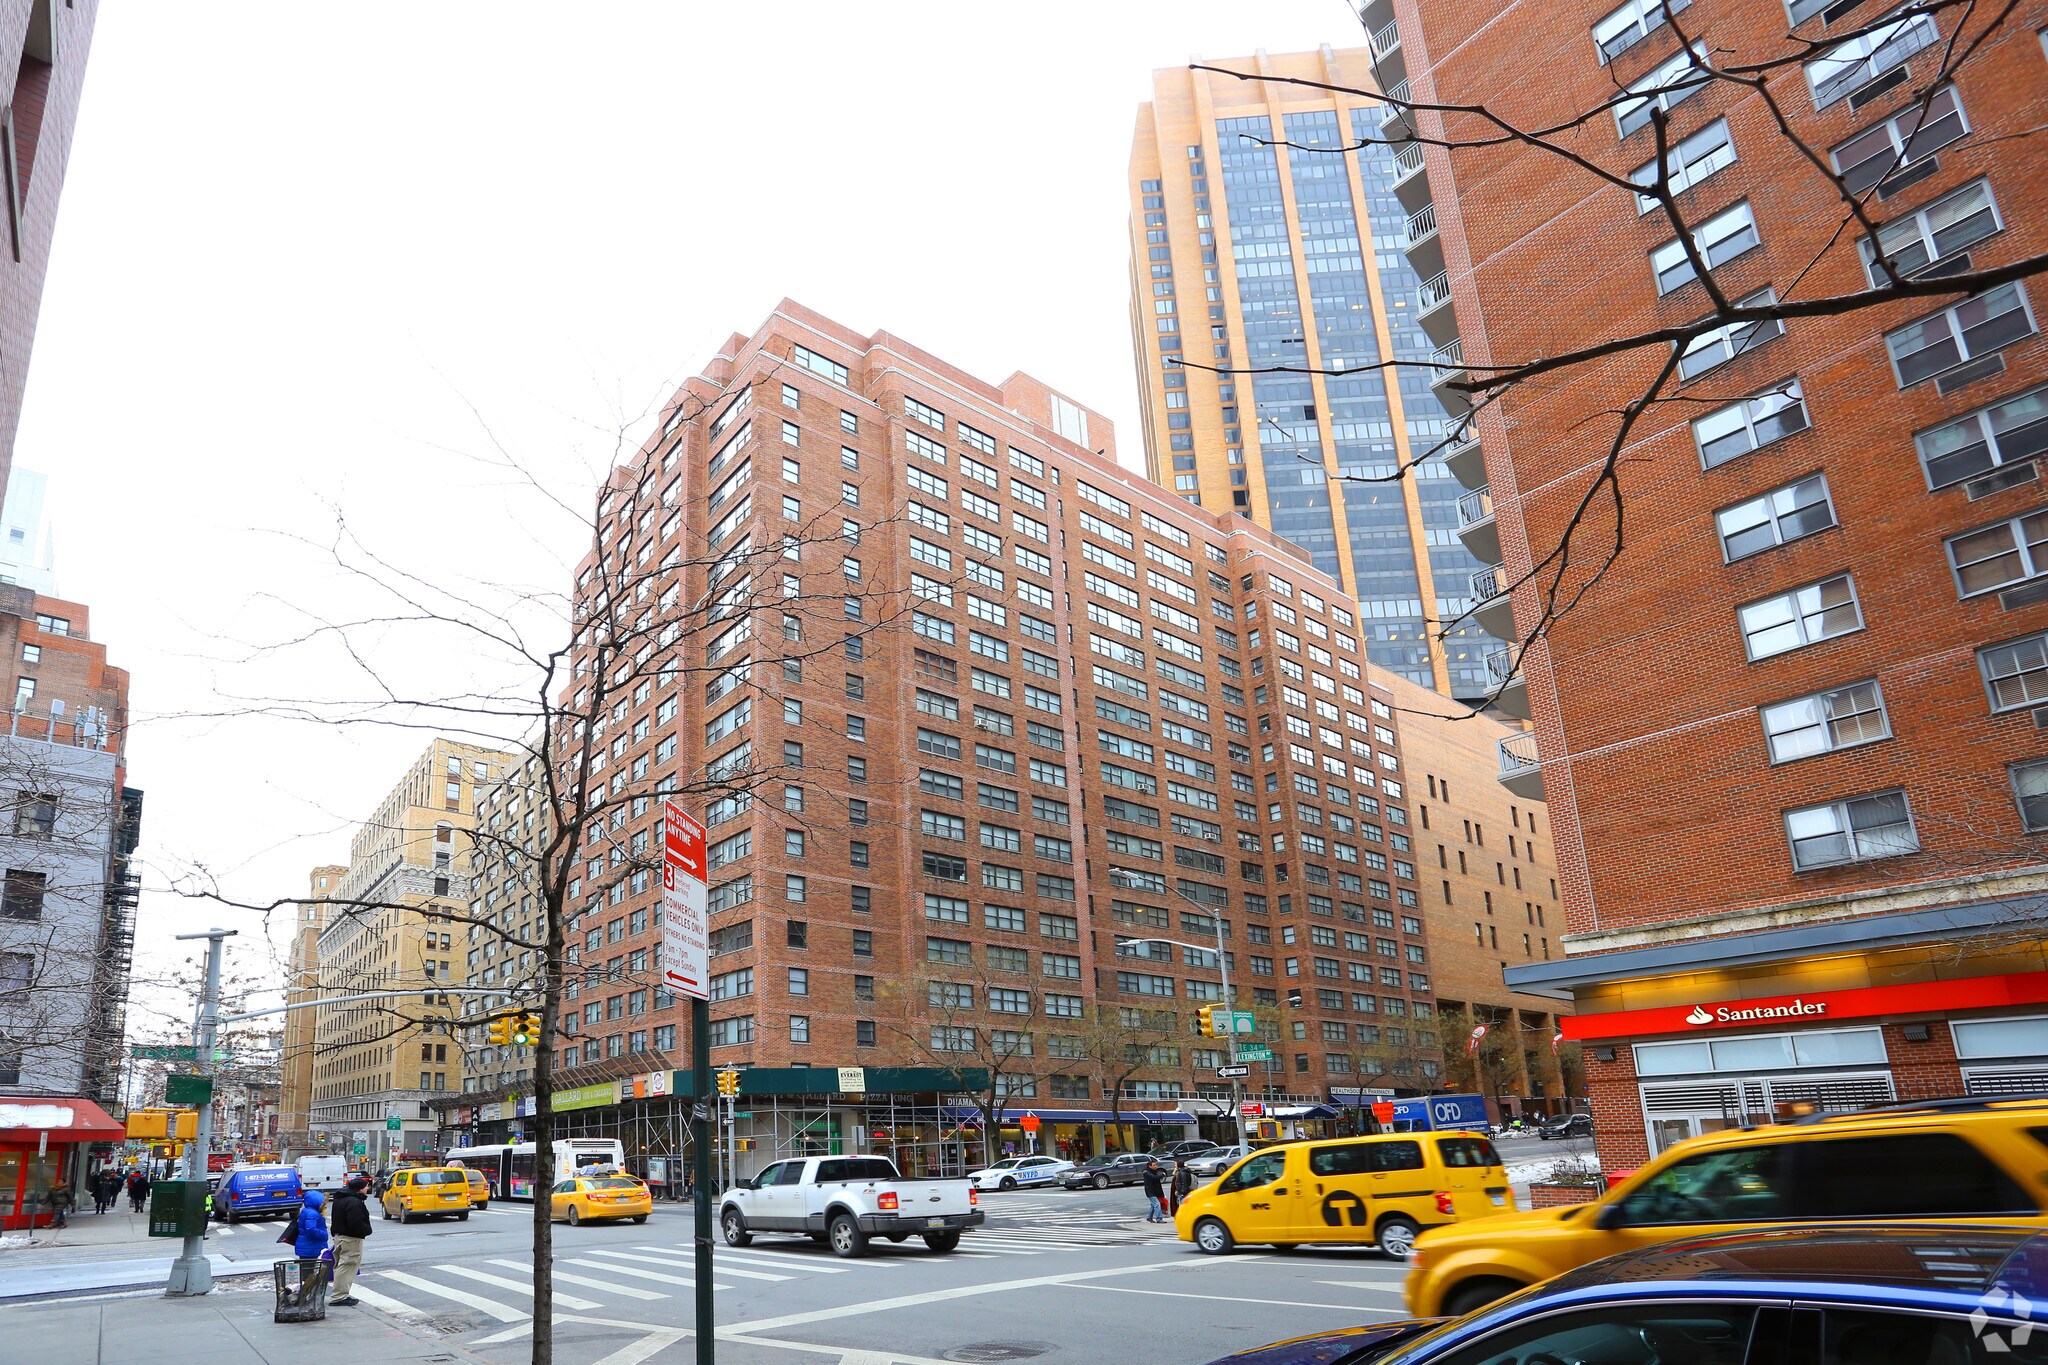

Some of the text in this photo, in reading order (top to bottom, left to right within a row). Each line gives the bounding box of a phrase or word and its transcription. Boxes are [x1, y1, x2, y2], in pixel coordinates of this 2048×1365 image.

[667, 807, 701, 840] NO STANDING
[667, 822, 691, 846] ANYTIME
[665, 863, 673, 887] 3
[666, 896, 699, 921] COMMERCIAL
[666, 909, 704, 936] VEHICLES ONLY
[666, 927, 705, 950] OTHERS NO STANDING
[666, 942, 675, 953] 7am
[679, 948, 688, 959] 7pm
[666, 954, 696, 975] Except Sunday
[1717, 999, 1826, 1022] Santander
[1238, 1052, 1265, 1060] LEXINGTON
[555, 1091, 581, 1104] GALLARD
[797, 1092, 847, 1101] GALLARD
[860, 1093, 912, 1102] PIZZA KING
[1393, 1106, 1409, 1115] OFD
[1435, 1102, 1461, 1121] OFD
[163, 1146, 170, 1156] 9
[1022, 1171, 1039, 1179] NYPD
[1328, 1199, 1357, 1227] T
